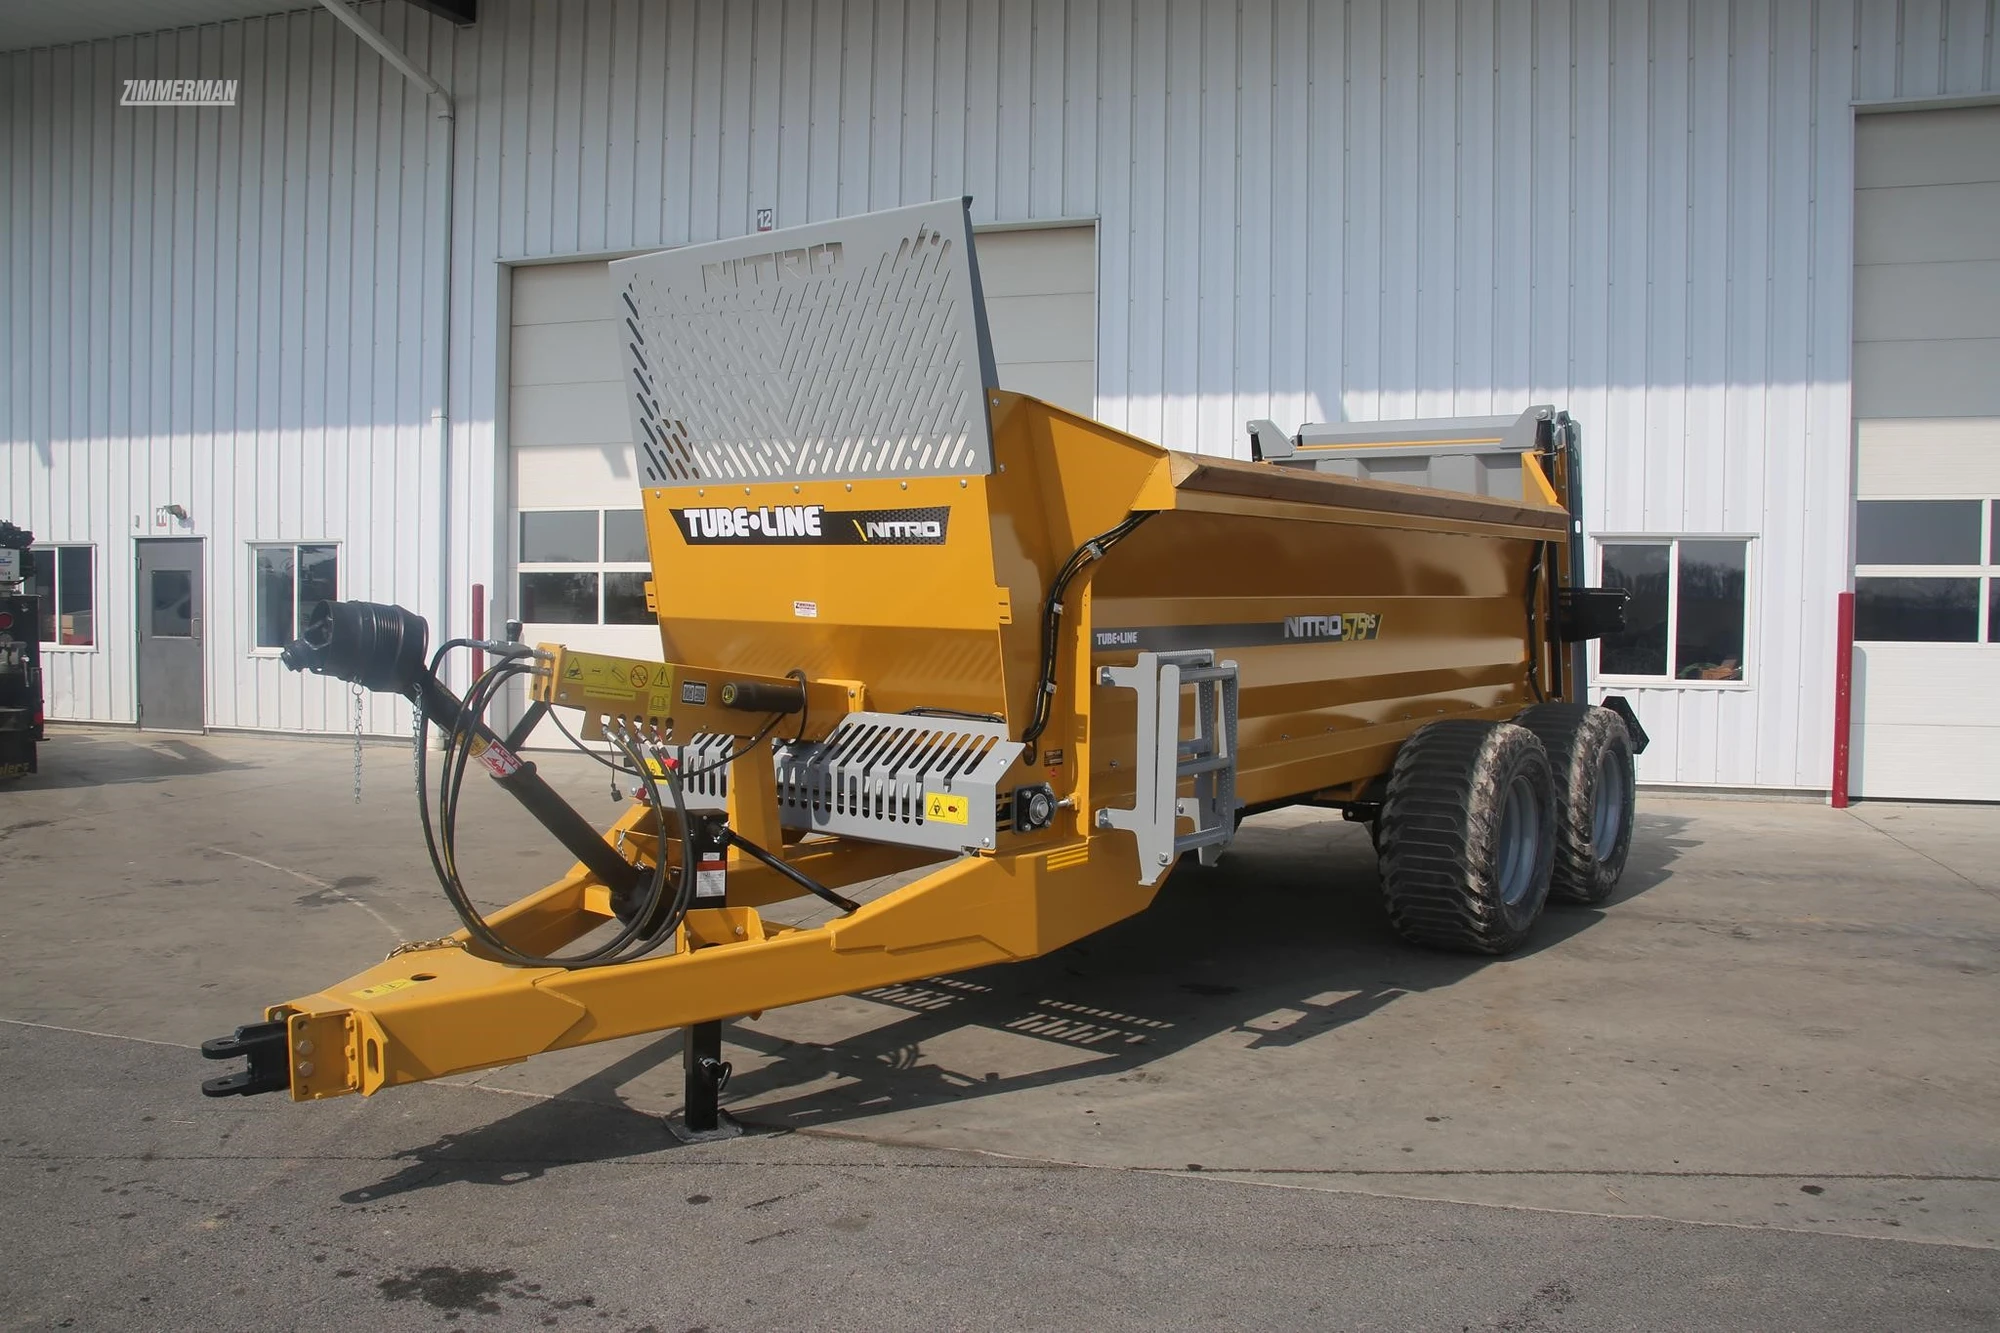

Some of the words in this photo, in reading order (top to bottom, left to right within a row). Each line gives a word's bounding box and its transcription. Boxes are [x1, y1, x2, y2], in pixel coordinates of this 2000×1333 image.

[757, 210, 772, 228] 12
[701, 241, 844, 294] NITRO
[866, 520, 941, 538] NITRO
[1284, 615, 1341, 638] NITRO
